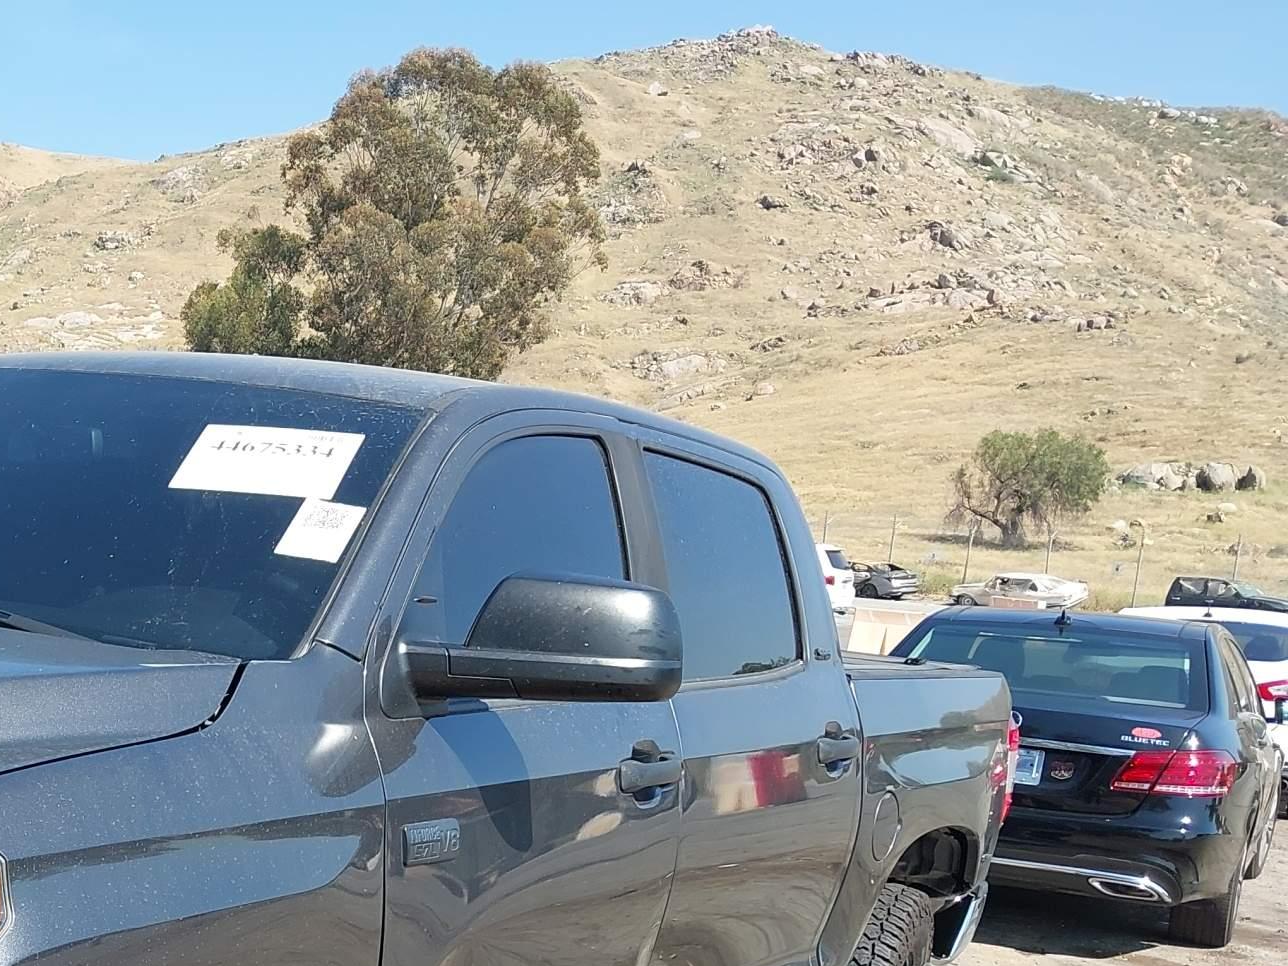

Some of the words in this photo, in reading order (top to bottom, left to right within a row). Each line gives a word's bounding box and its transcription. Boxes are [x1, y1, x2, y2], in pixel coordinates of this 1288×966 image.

[210, 439, 336, 459] 44675334
[1120, 735, 1170, 746] BLUETEC
[441, 831, 460, 852] V8
